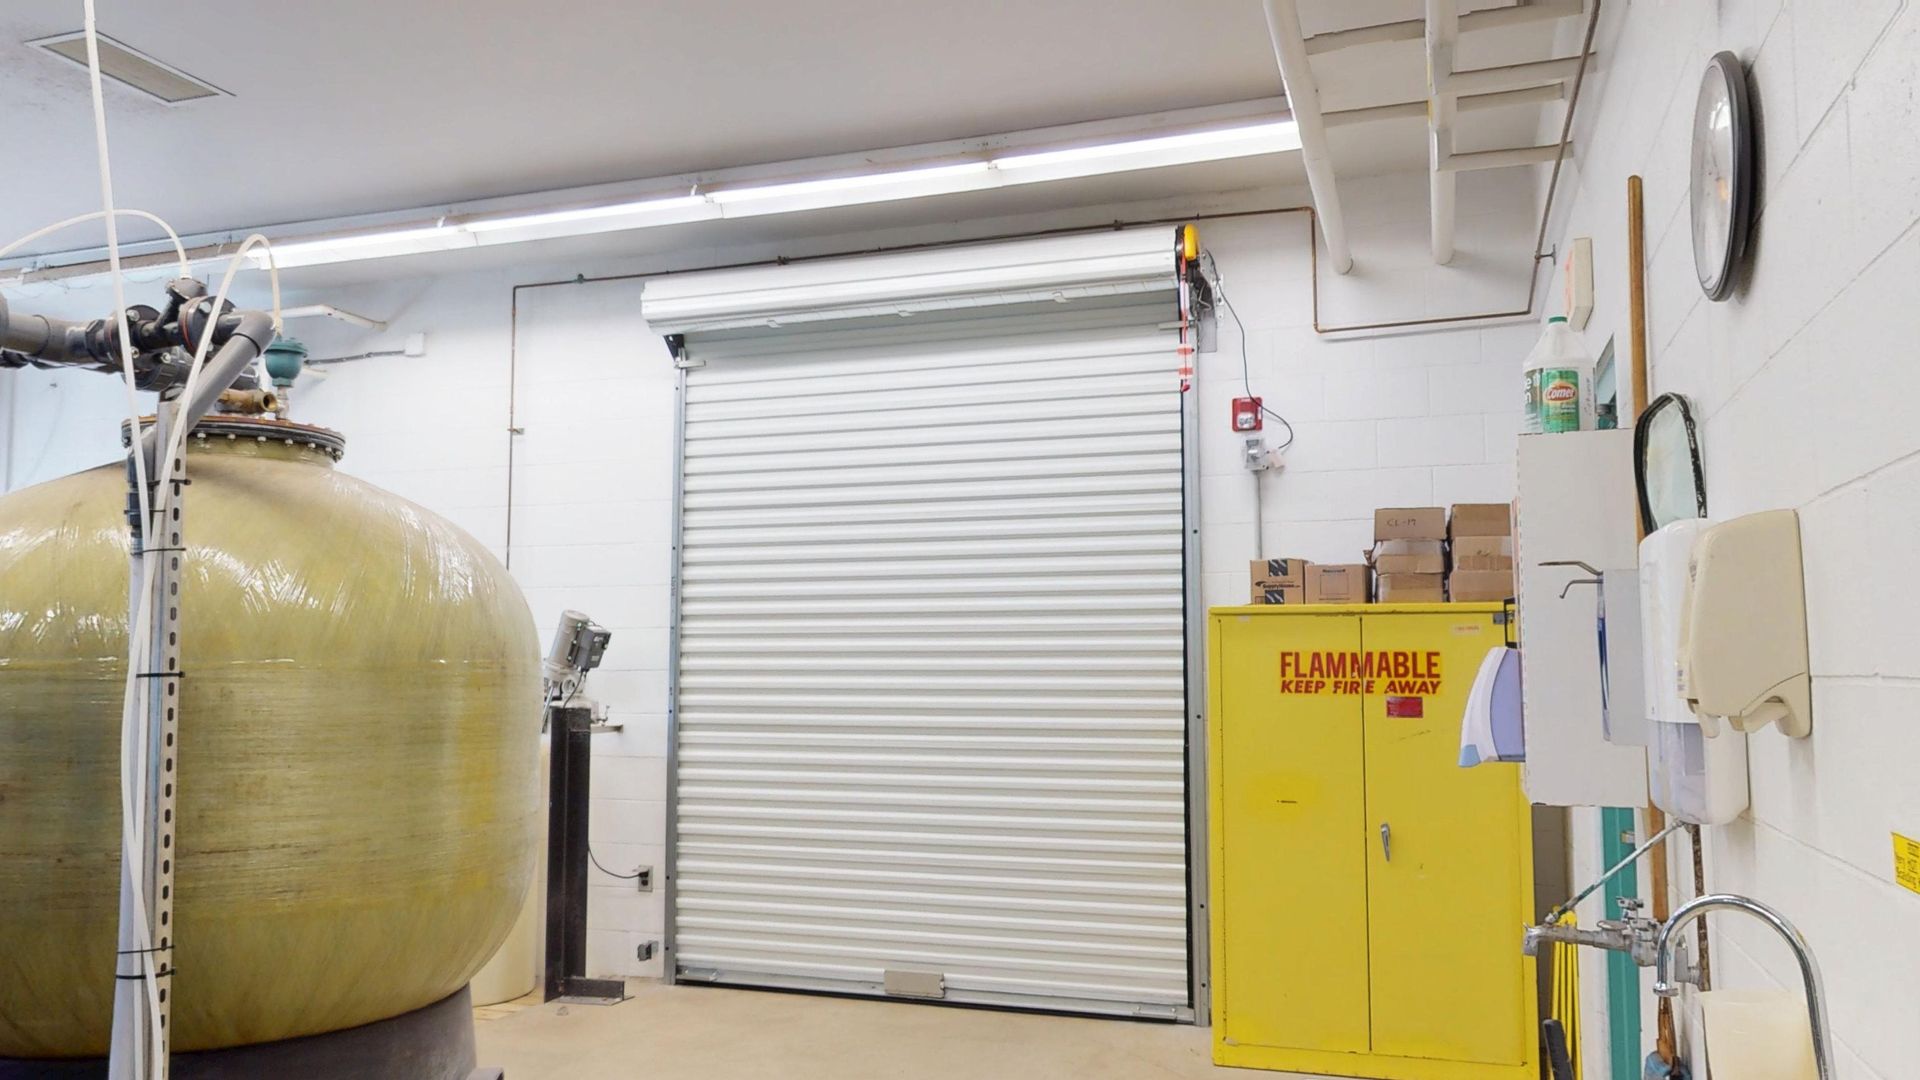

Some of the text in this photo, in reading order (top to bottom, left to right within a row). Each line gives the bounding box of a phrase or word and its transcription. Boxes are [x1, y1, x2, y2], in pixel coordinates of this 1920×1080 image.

[1547, 387, 1576, 400] Comet
[1280, 652, 1441, 679] FLAMMABLE
[1281, 680, 1442, 694] KEEP FIRE AWAY
